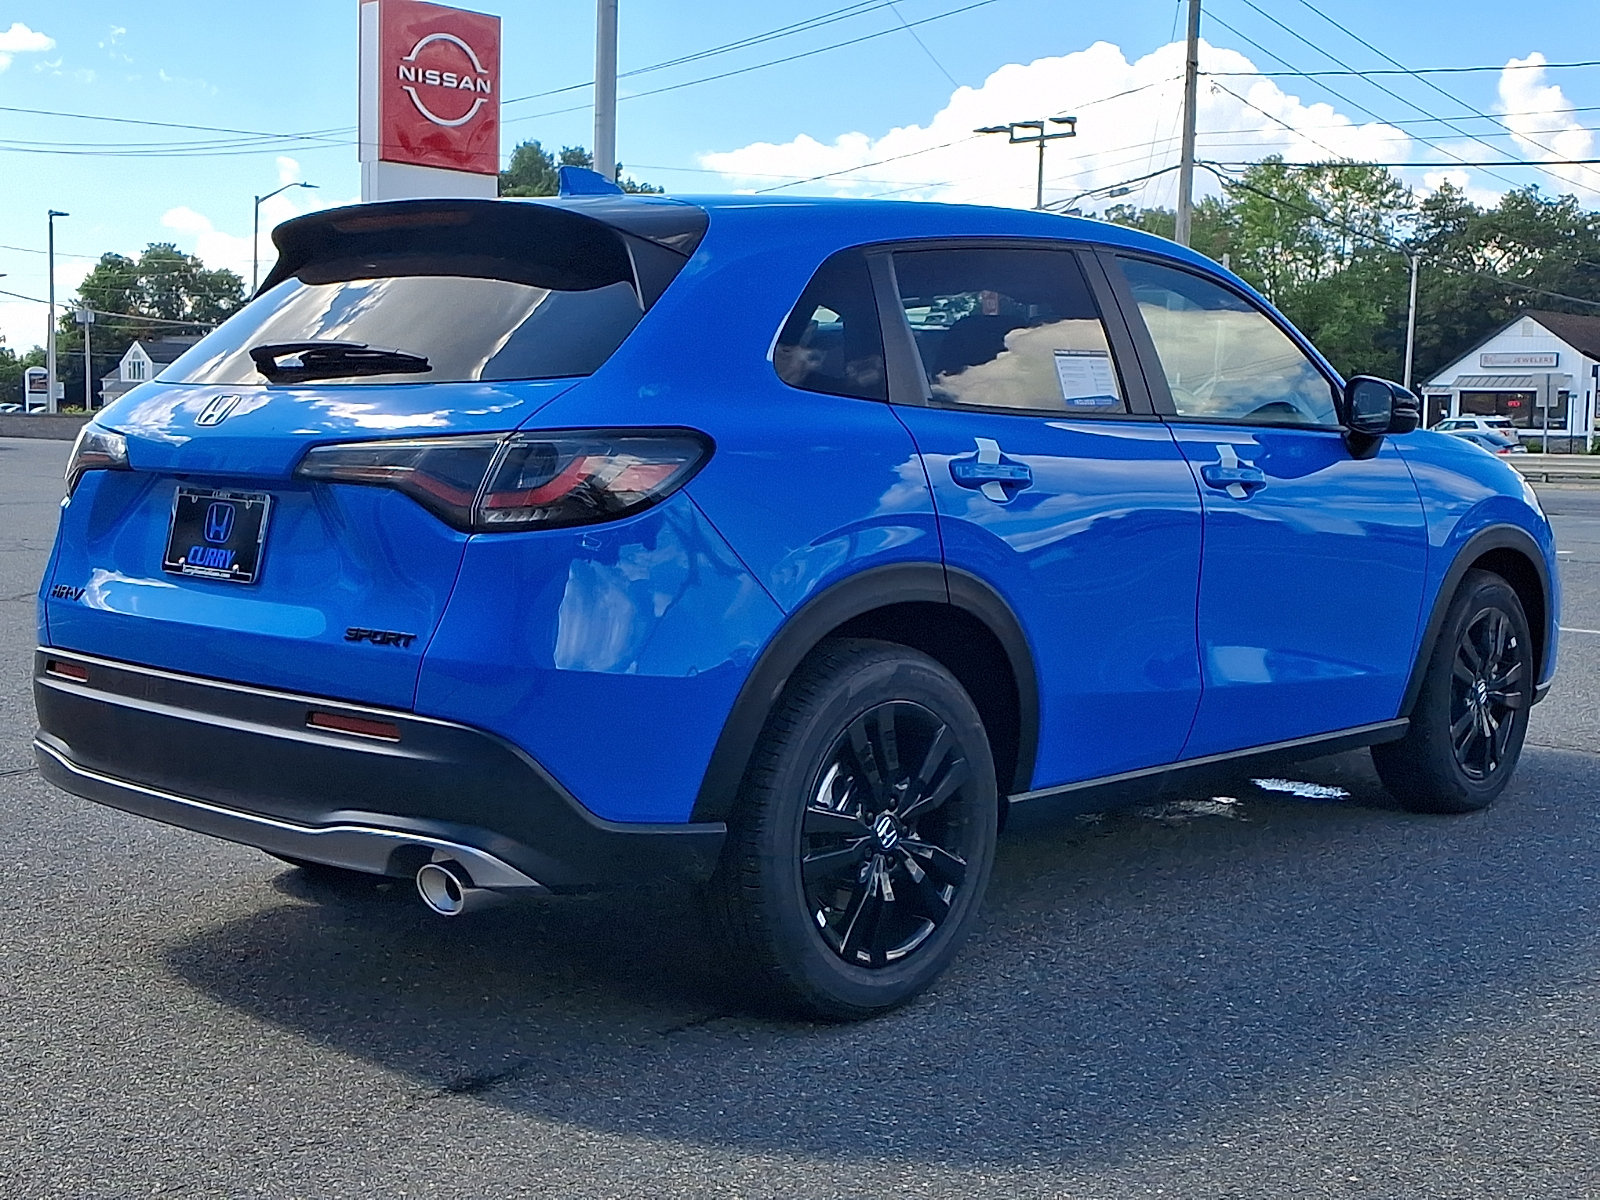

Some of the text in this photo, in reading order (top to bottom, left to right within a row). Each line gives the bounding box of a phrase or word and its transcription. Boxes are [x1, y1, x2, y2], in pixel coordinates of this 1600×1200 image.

[399, 65, 491, 94] NISSAN
[1512, 356, 1554, 365] JEWELERS
[187, 545, 236, 569] CURRY
[343, 627, 418, 648] SPORT
